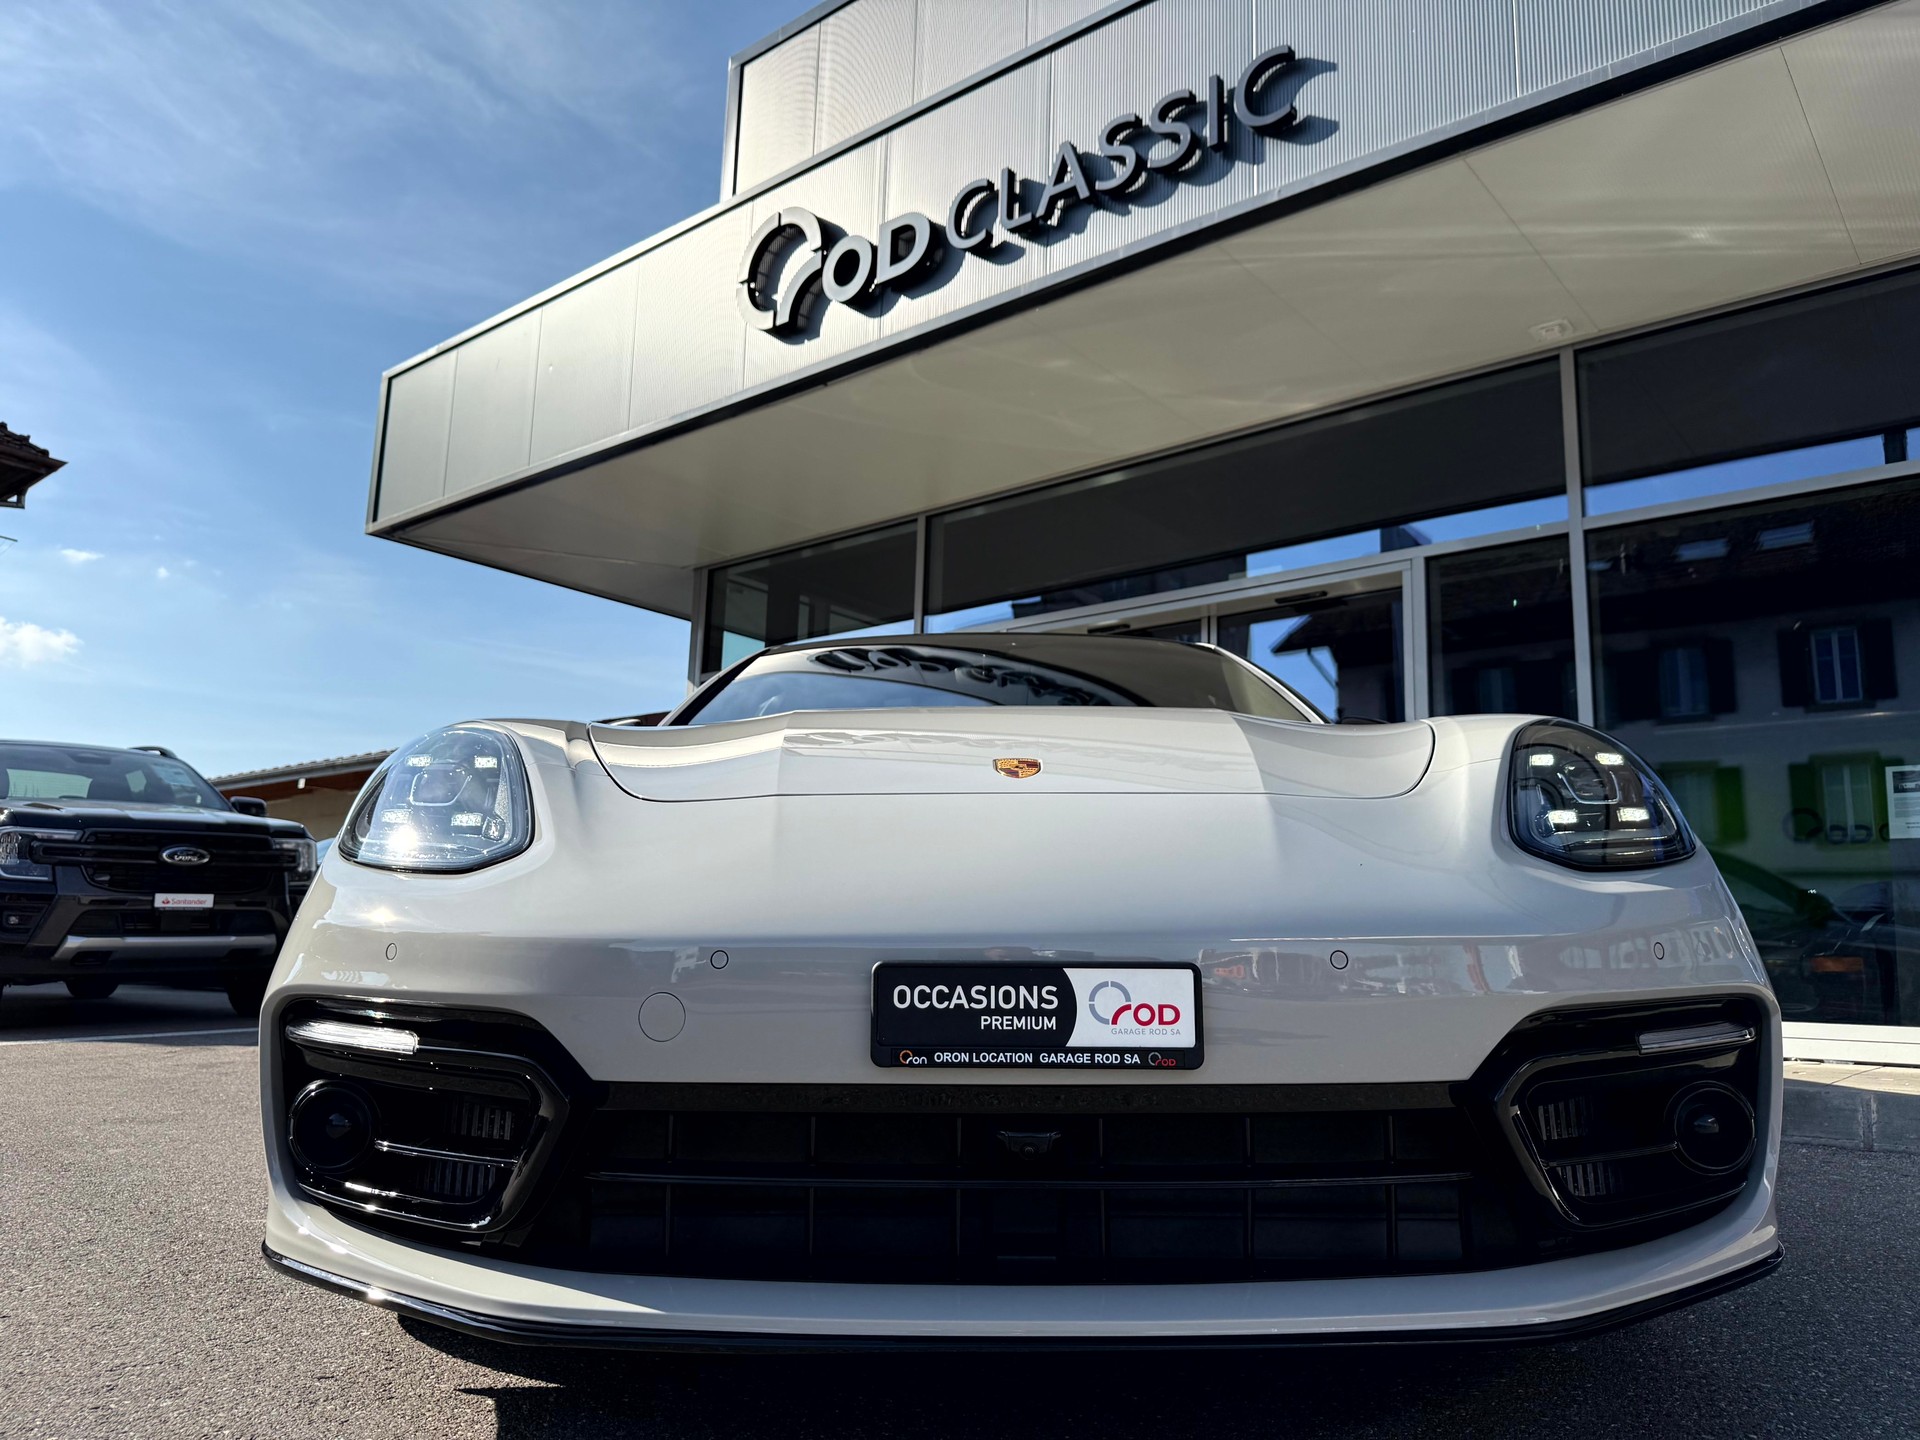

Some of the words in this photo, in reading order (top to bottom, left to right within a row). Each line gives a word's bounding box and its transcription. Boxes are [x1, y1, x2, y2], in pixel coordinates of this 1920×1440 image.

[945, 44, 1298, 250] CLASSIC
[893, 985, 1059, 1010] OCCASIONS
[980, 1016, 1056, 1030] PREMIUM
[1111, 1028, 1147, 1036] GARAGE
[1149, 1028, 1168, 1036] ROD
[1170, 1028, 1181, 1036] SA
[934, 1052, 969, 1063] ORON
[973, 1052, 1033, 1063] LOCATION
[1039, 1053, 1091, 1064] GARAGE
[1094, 1053, 1121, 1064] ROD
[1124, 1053, 1141, 1064] SA
